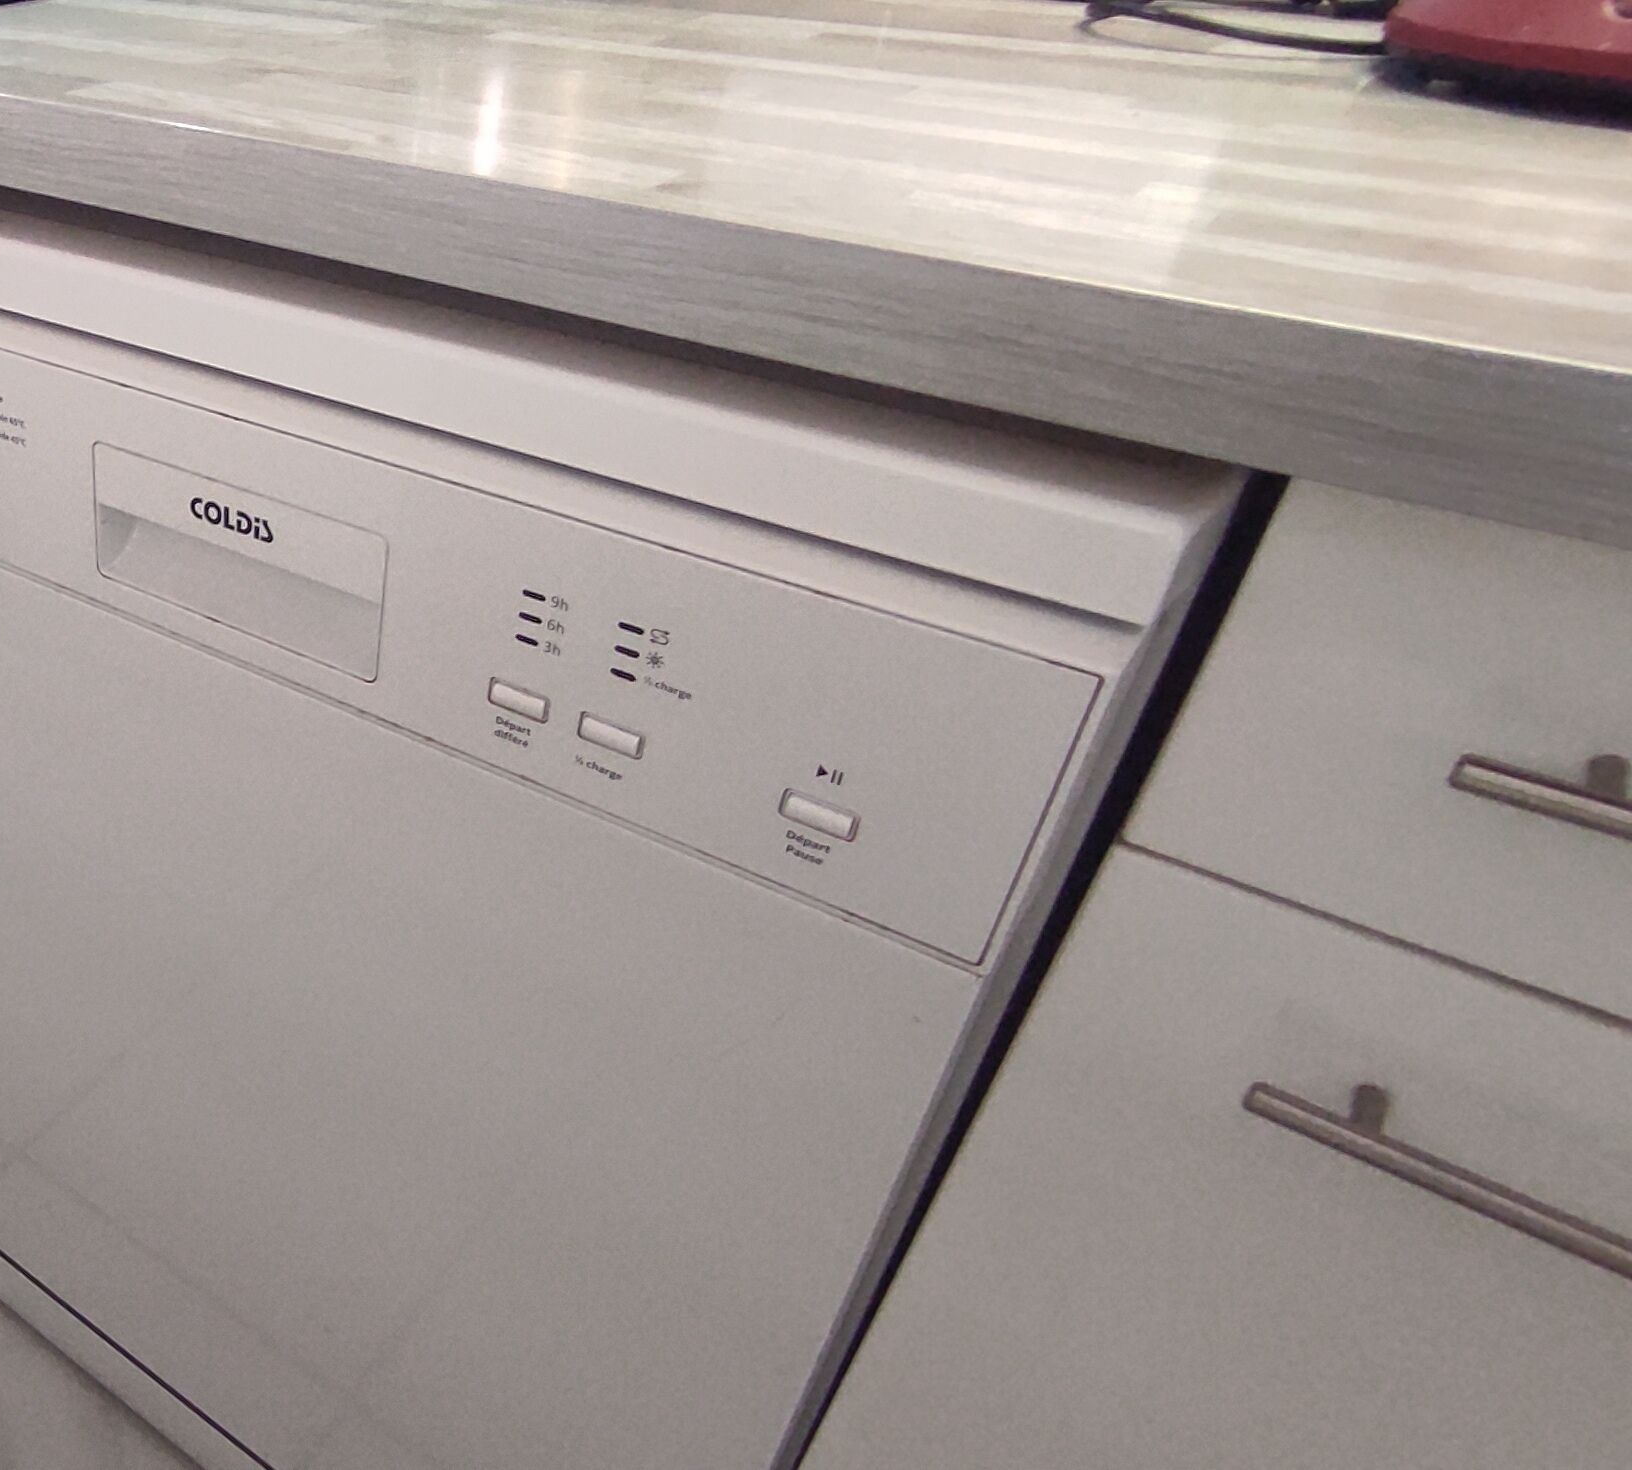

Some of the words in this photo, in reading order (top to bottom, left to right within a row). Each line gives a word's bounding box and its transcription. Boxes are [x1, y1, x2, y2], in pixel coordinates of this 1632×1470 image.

[551, 595, 569, 612] 9h
[546, 618, 565, 635] 6h
[542, 640, 561, 657] 3h
[654, 680, 693, 700] charge
[585, 760, 624, 781] charge
[785, 829, 831, 854] Départ
[785, 844, 825, 865] Pause
